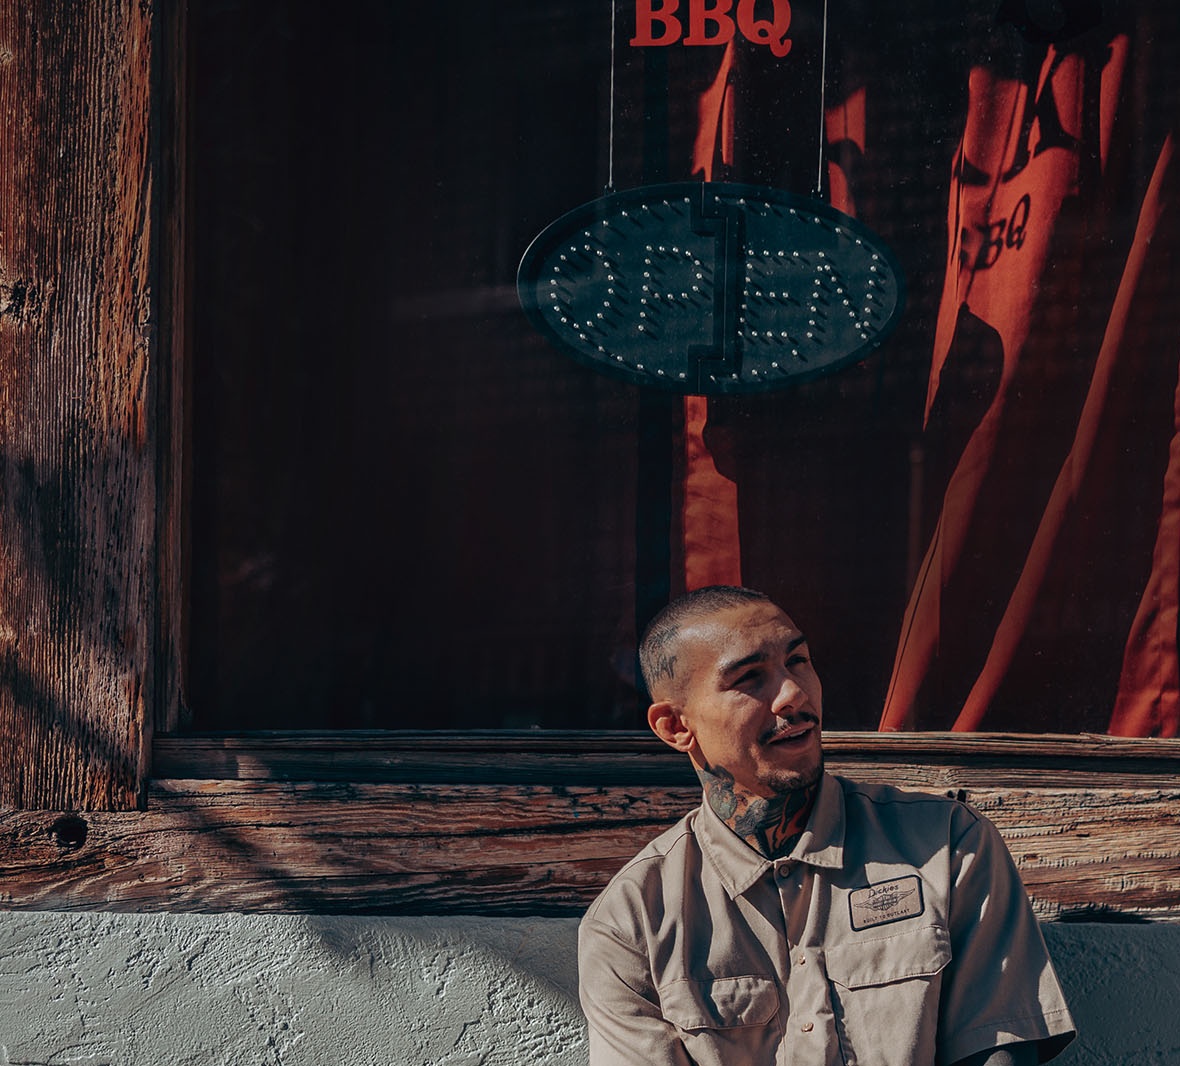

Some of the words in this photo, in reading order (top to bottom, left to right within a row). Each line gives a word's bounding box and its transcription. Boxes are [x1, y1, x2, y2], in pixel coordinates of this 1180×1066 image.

[629, 0, 793, 57] BBQ
[549, 243, 880, 340] OPEN
[868, 884, 899, 898] Dickies
